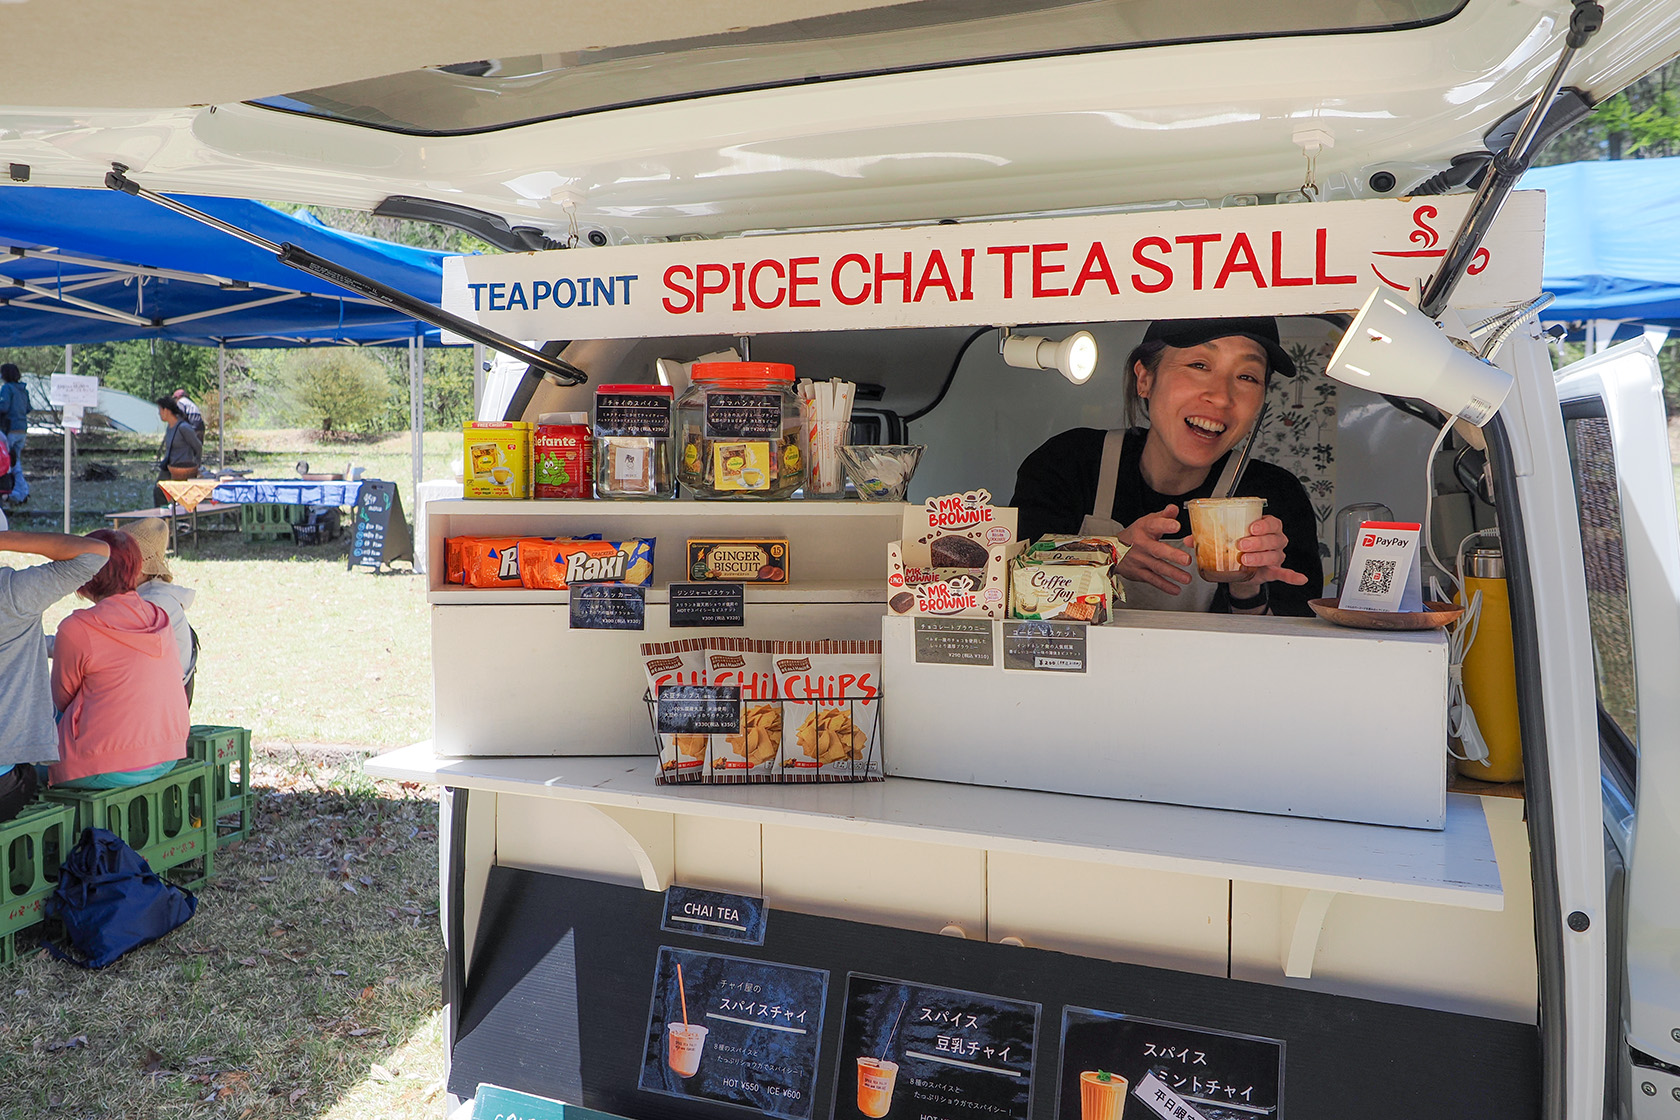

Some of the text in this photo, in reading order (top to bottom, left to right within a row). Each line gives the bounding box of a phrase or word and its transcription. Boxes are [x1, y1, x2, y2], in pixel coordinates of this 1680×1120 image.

[468, 228, 1358, 315] TEA POINT SPICE CHAI TEA STALL
[772, 547, 782, 555] 15
[1375, 536, 1409, 549] PayPay
[565, 550, 626, 582] Raxi
[713, 551, 761, 561] GINGER
[714, 562, 761, 572] BISCUIT
[1031, 570, 1072, 590] Coffee
[1047, 587, 1075, 603] Joy
[683, 902, 740, 922] CHAI TEA
[719, 979, 762, 994] チャイ屋の
[719, 998, 807, 1024] スパイスチャイ
[920, 1007, 979, 1030] スパイス
[713, 1043, 758, 1057] 8種のスパイスと
[934, 1034, 1011, 1062] 豆乳チャイ
[1143, 1042, 1208, 1066] スパイス
[723, 1078, 801, 1100] HOT ¥550 ICE ¥600
[909, 1077, 961, 1093] 8種のスパイスと
[1158, 1070, 1254, 1101] ミントチャイ
